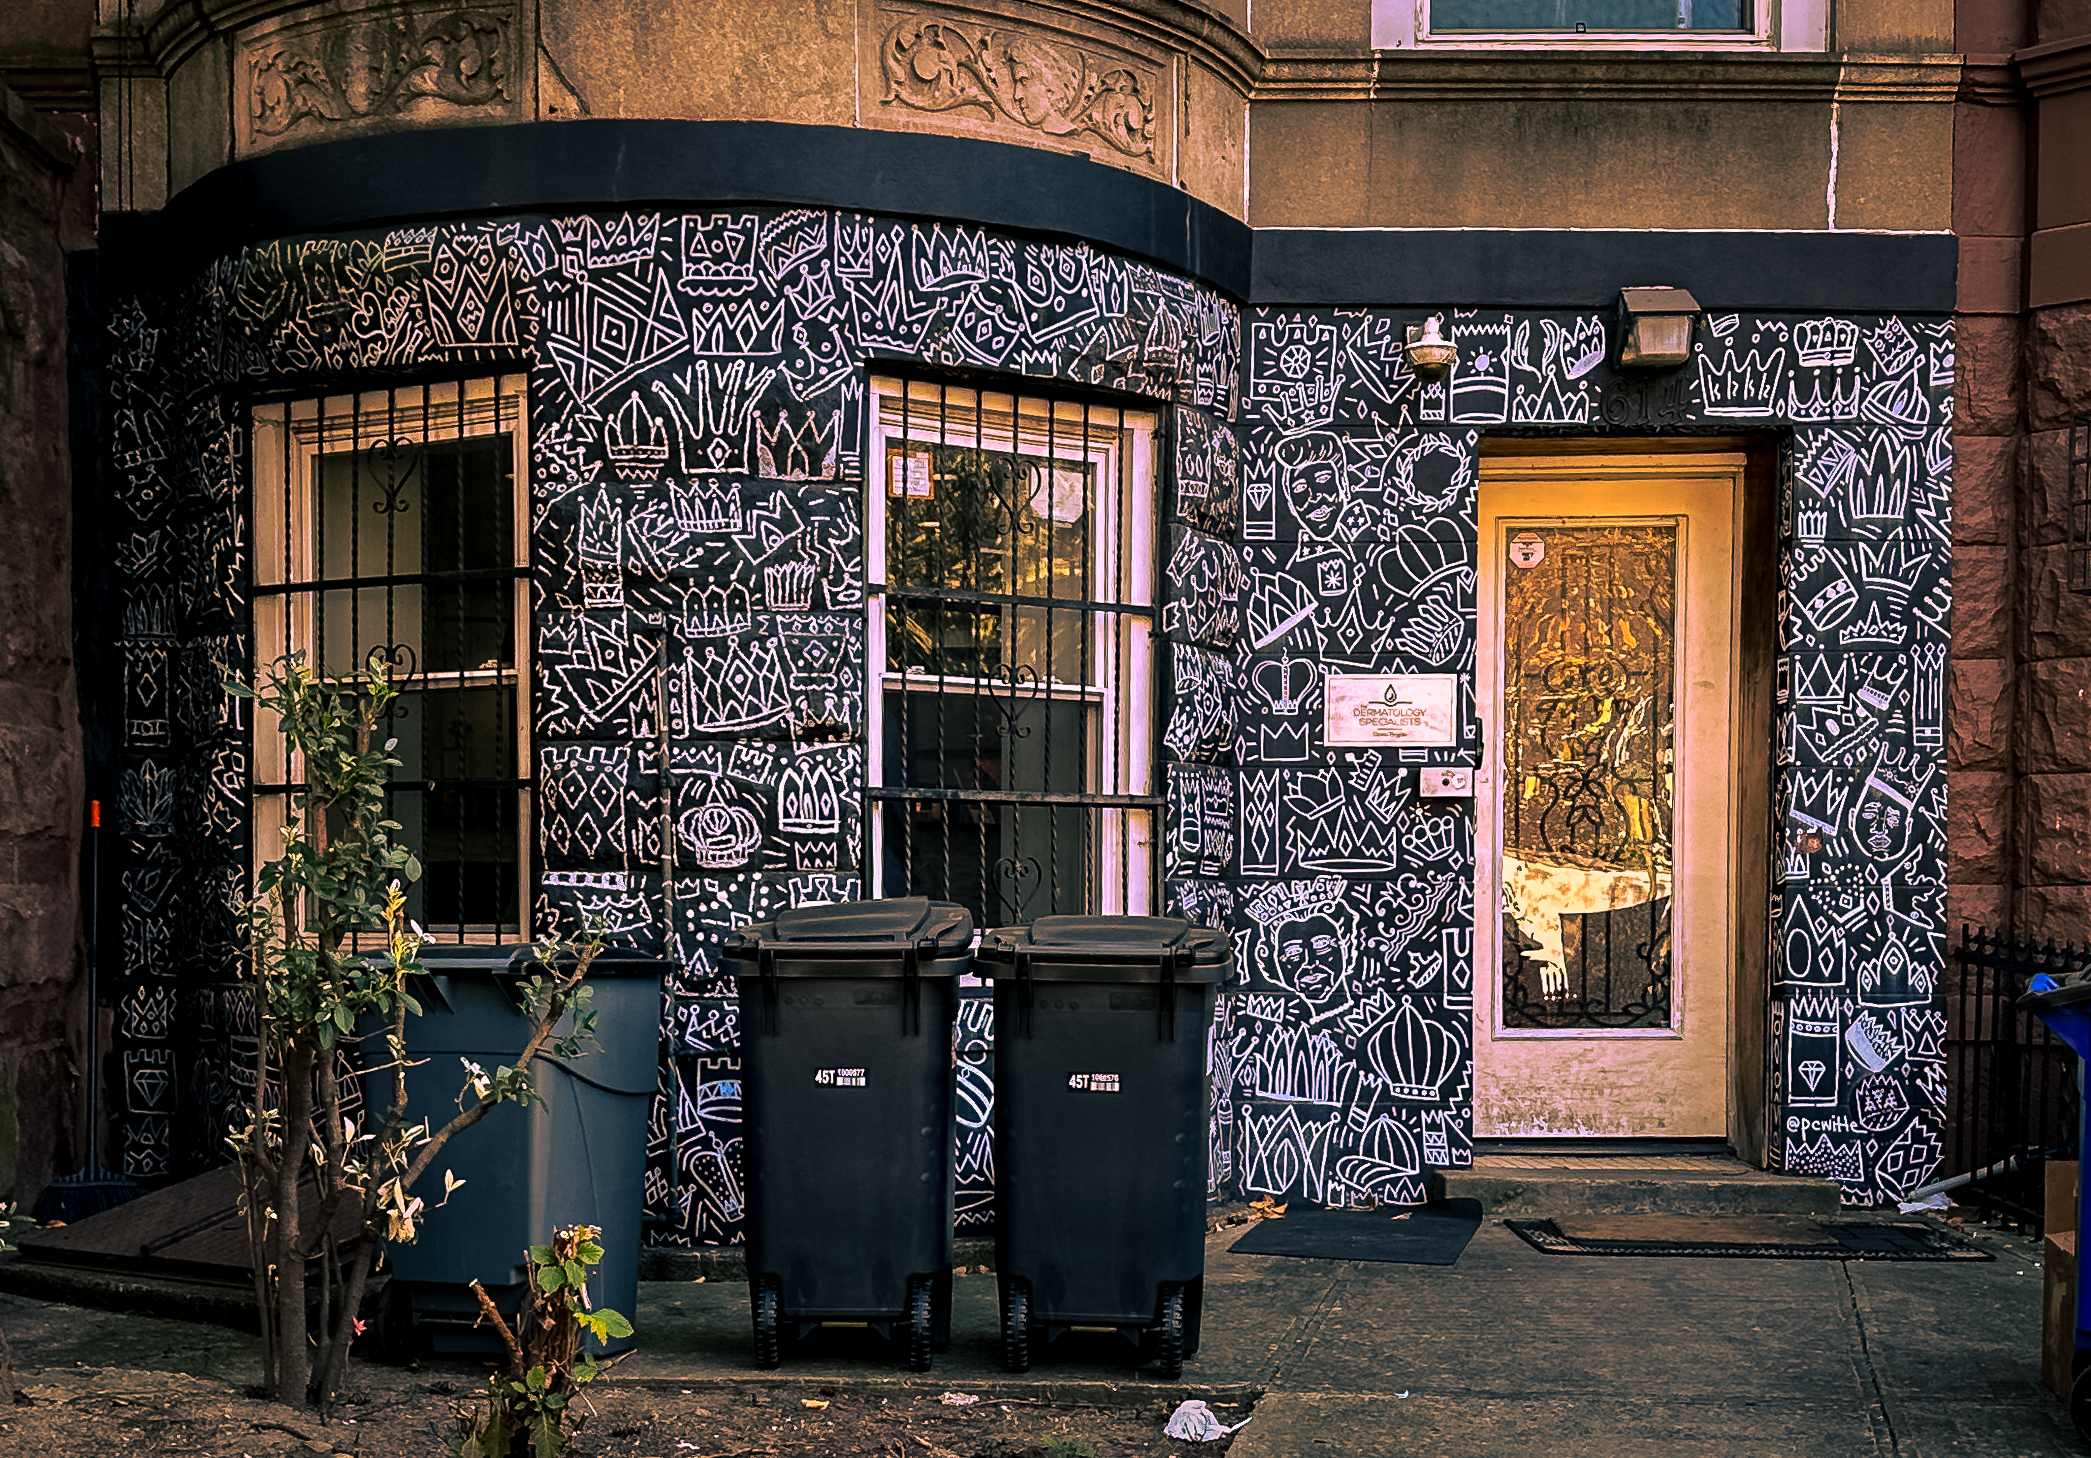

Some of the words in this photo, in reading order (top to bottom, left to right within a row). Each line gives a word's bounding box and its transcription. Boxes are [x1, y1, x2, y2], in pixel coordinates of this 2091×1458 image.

[1601, 376, 1689, 425] 614
[1353, 708, 1427, 717] DERMATOLOGY
[1359, 717, 1422, 726] SPECIALISTS
[815, 1069, 836, 1085] 45T
[1068, 1074, 1090, 1089] 45T
